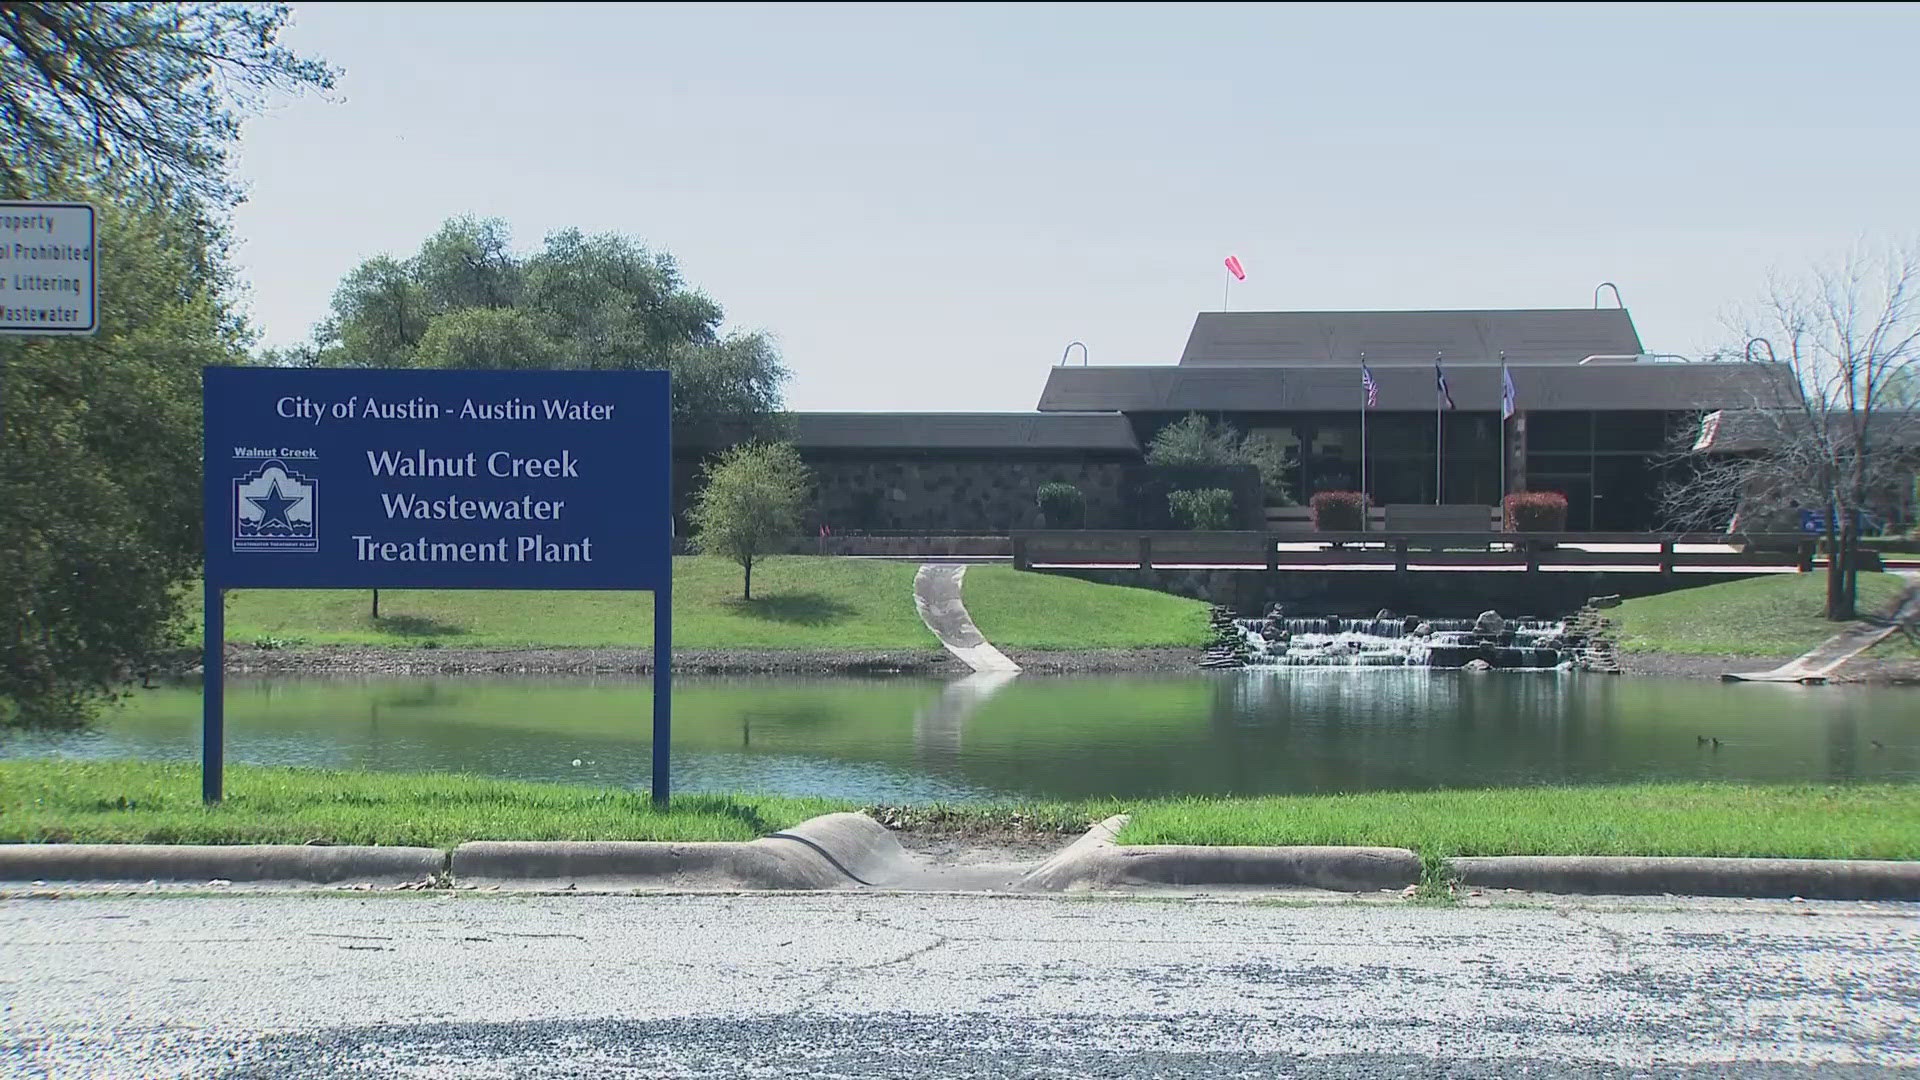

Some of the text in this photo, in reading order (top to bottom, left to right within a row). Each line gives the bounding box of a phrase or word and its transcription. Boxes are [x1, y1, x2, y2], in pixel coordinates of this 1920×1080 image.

[15, 243, 90, 260] Prohibited
[15, 274, 80, 295] Littering
[276, 396, 326, 426] City
[332, 396, 357, 419] of
[362, 397, 439, 419] Austin
[459, 398, 536, 420] Austin
[541, 399, 615, 421] Water
[234, 447, 317, 457] Walnut Creek
[366, 448, 579, 478] Walnut Creek
[381, 493, 565, 520] Wastewater
[351, 534, 593, 562] Treatment Plant
